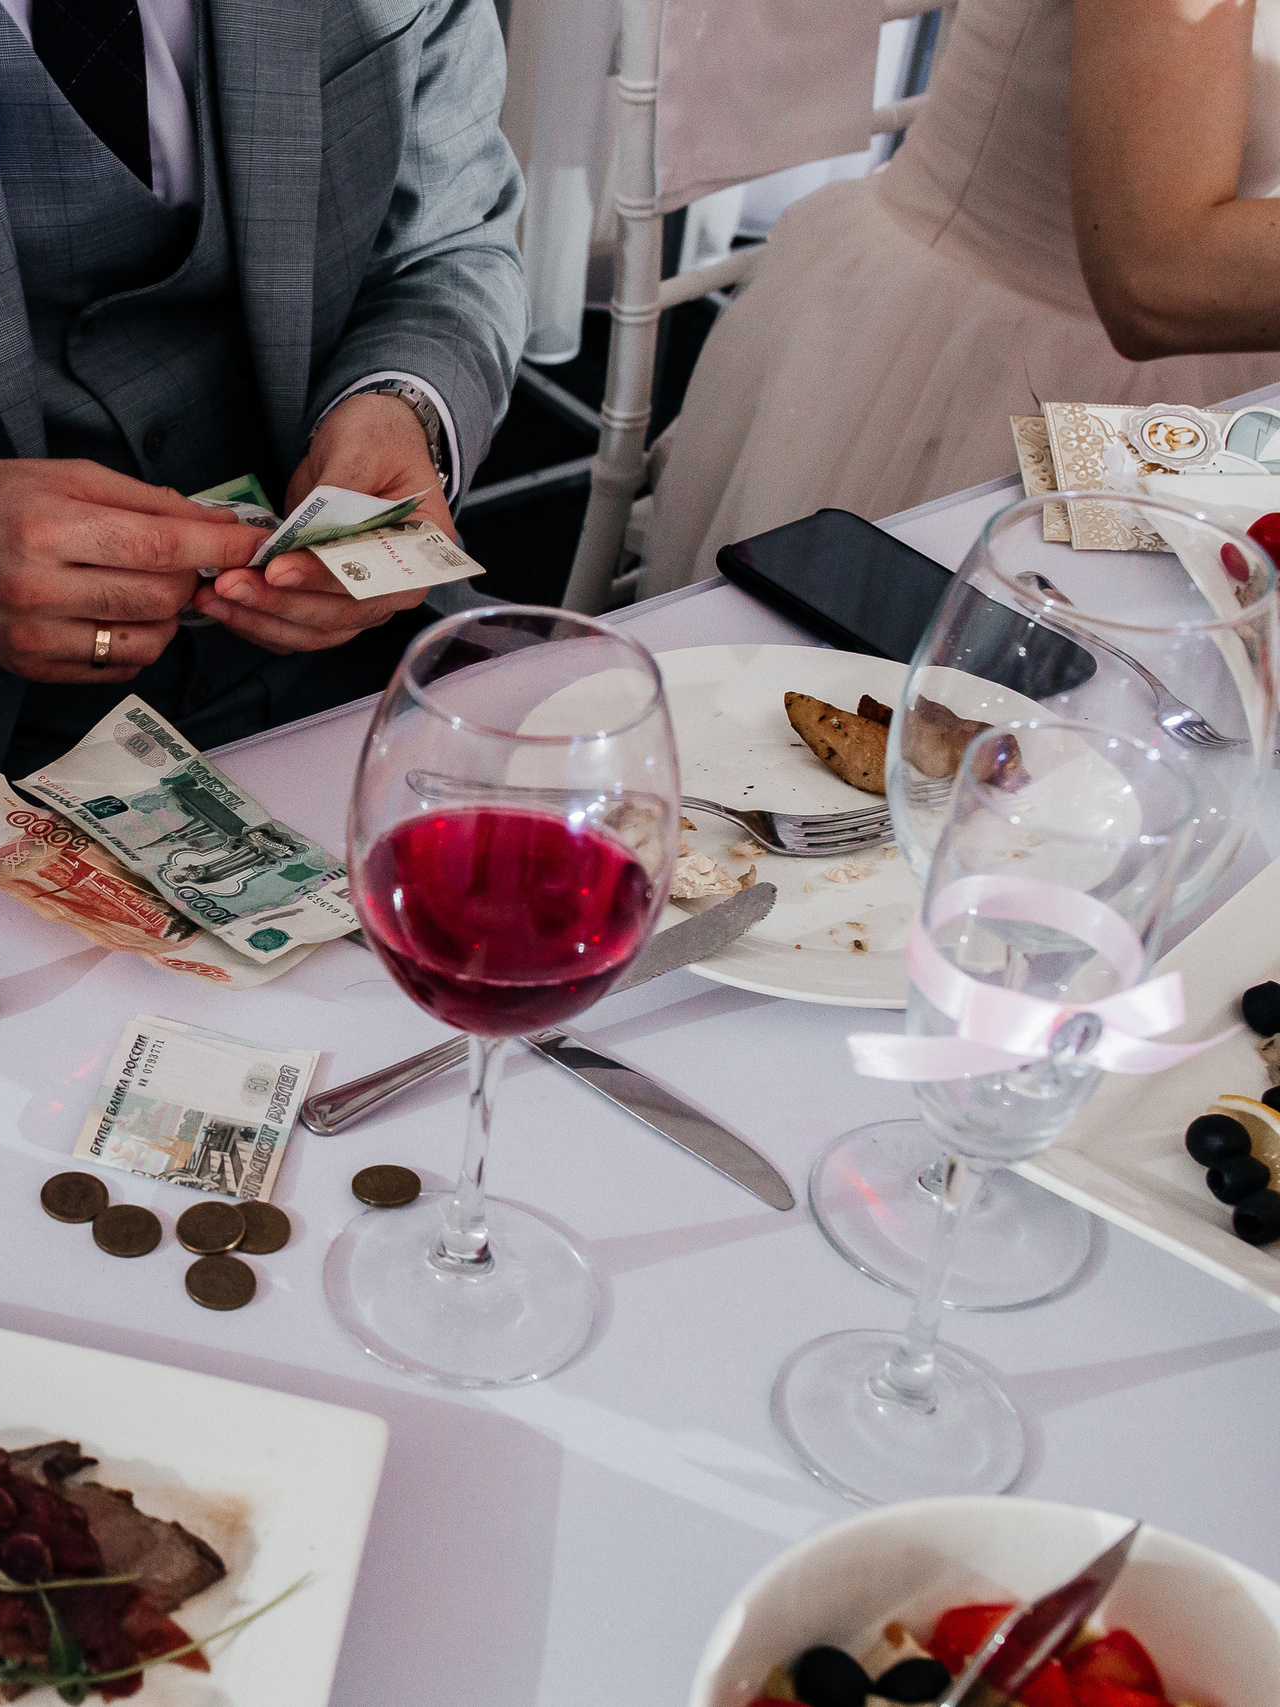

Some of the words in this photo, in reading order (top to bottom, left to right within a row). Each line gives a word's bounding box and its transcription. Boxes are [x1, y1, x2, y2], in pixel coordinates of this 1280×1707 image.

[124, 707, 192, 762] РУБЛЕЙ
[128, 735, 150, 755] 1000
[186, 760, 246, 810] ТЫСЯЧА
[6, 810, 95, 855] 5000
[74, 809, 111, 836] БАНКА
[106, 836, 142, 863] БИЛЕТ
[174, 886, 240, 926] 1000
[295, 885, 340, 915] 6495213
[142, 1039, 165, 1075] 0793771
[90, 1116, 116, 1157] БИЛЕТ
[106, 1079, 132, 1117] БАНКА
[122, 1034, 150, 1078] РОССИИ
[248, 1077, 270, 1092] 50
[240, 1123, 280, 1200] ЯТЬДЕСЯТ
[265, 1064, 301, 1125] РУБЛЕЙ
